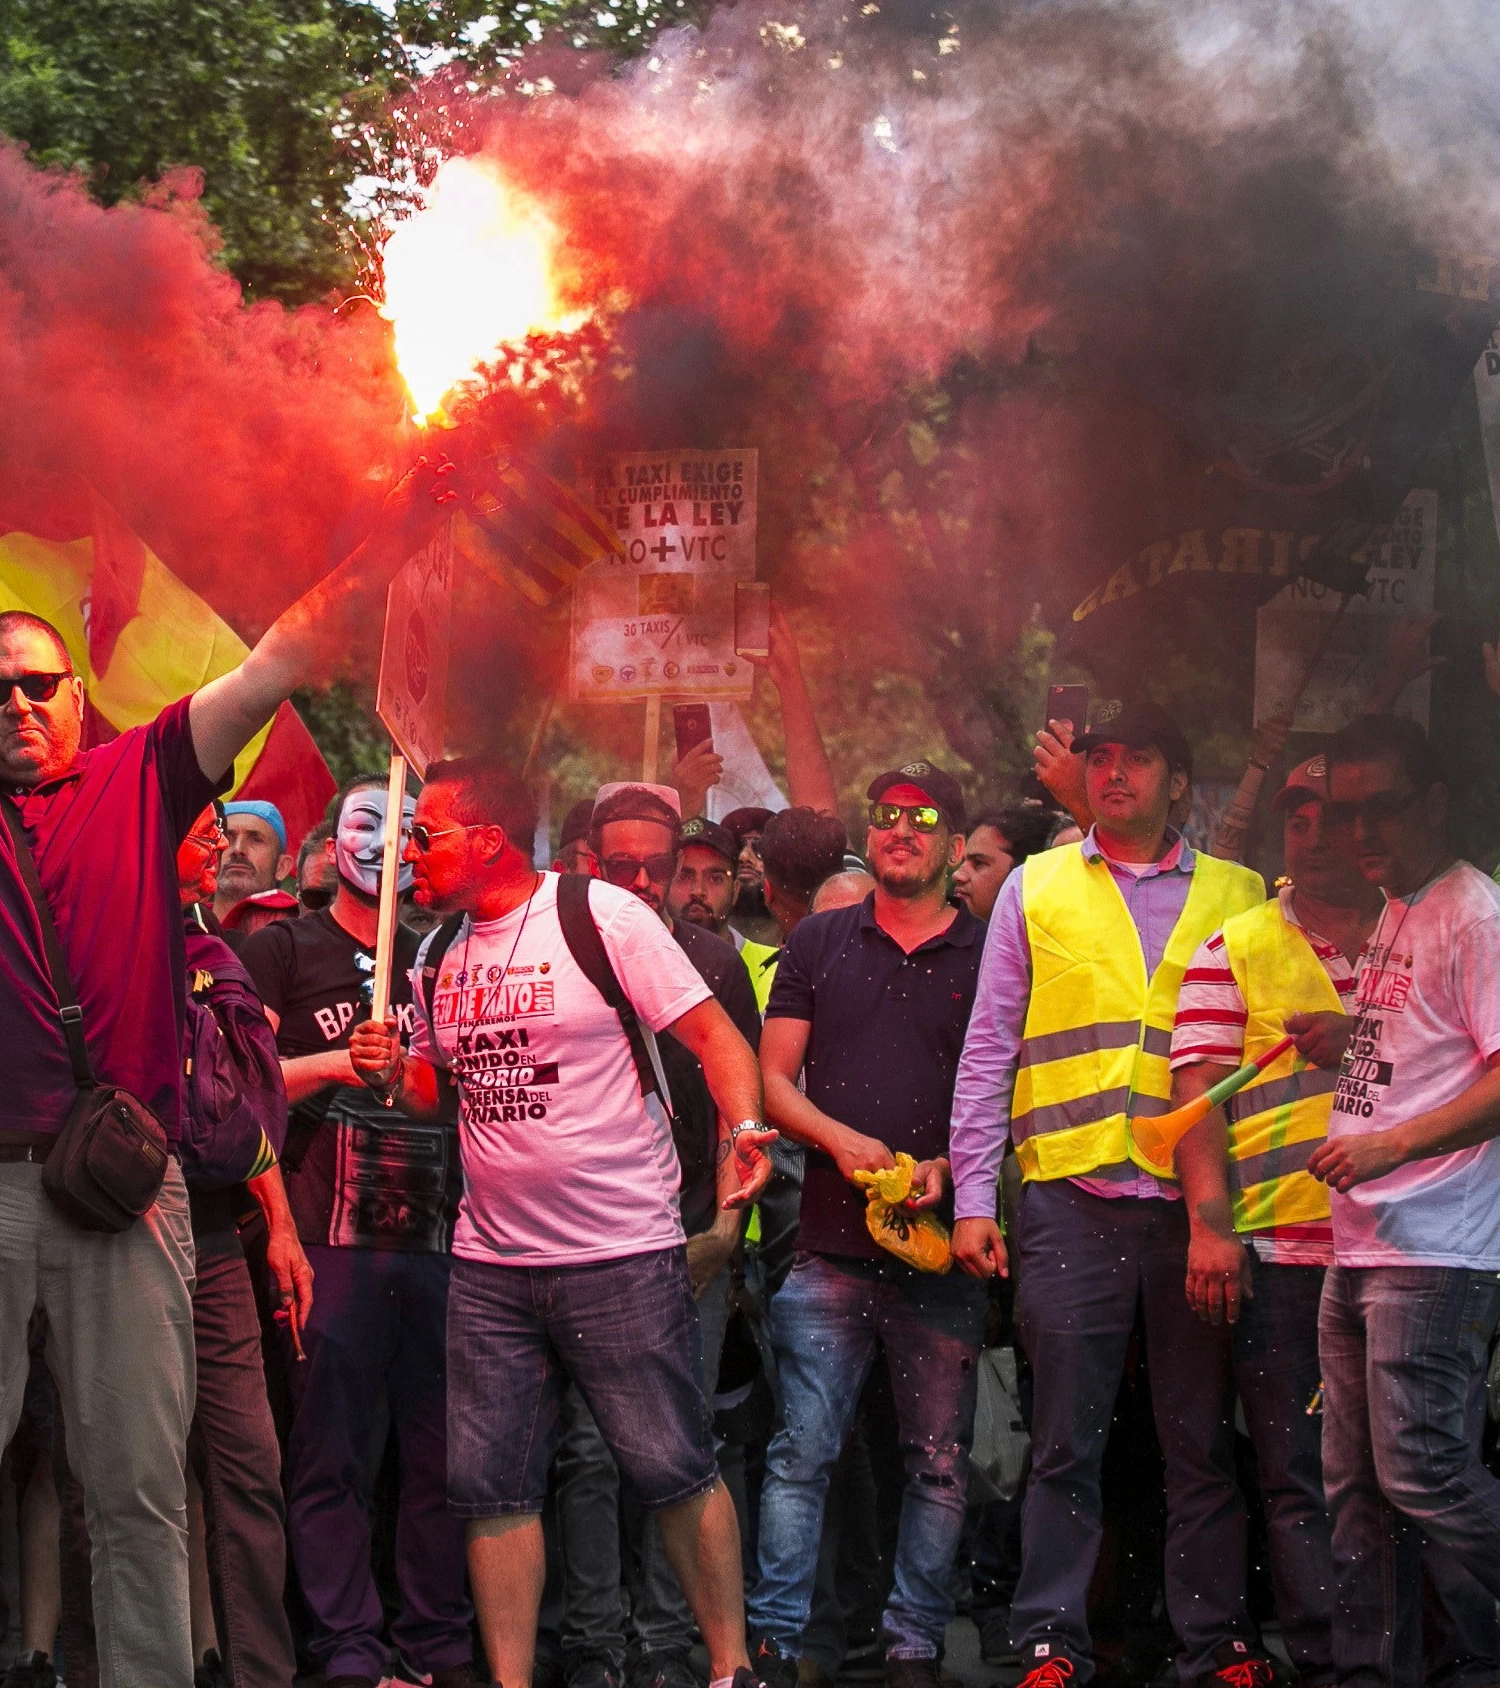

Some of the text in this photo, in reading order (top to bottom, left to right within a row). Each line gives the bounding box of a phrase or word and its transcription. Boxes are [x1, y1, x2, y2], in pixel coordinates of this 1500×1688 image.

[626, 462, 671, 486] TAXI
[680, 460, 744, 483] EXIGE
[617, 483, 743, 505] CUMPLIMIENTO
[644, 502, 678, 528] LA
[692, 501, 744, 527] LEY
[623, 620, 670, 637] 30 TAXIS
[481, 983, 532, 1018] MAYO
[534, 981, 554, 1011] 2017
[458, 1028, 530, 1055] TAXI
[520, 1054, 537, 1066] EN
[530, 1091, 553, 1103] DEL
